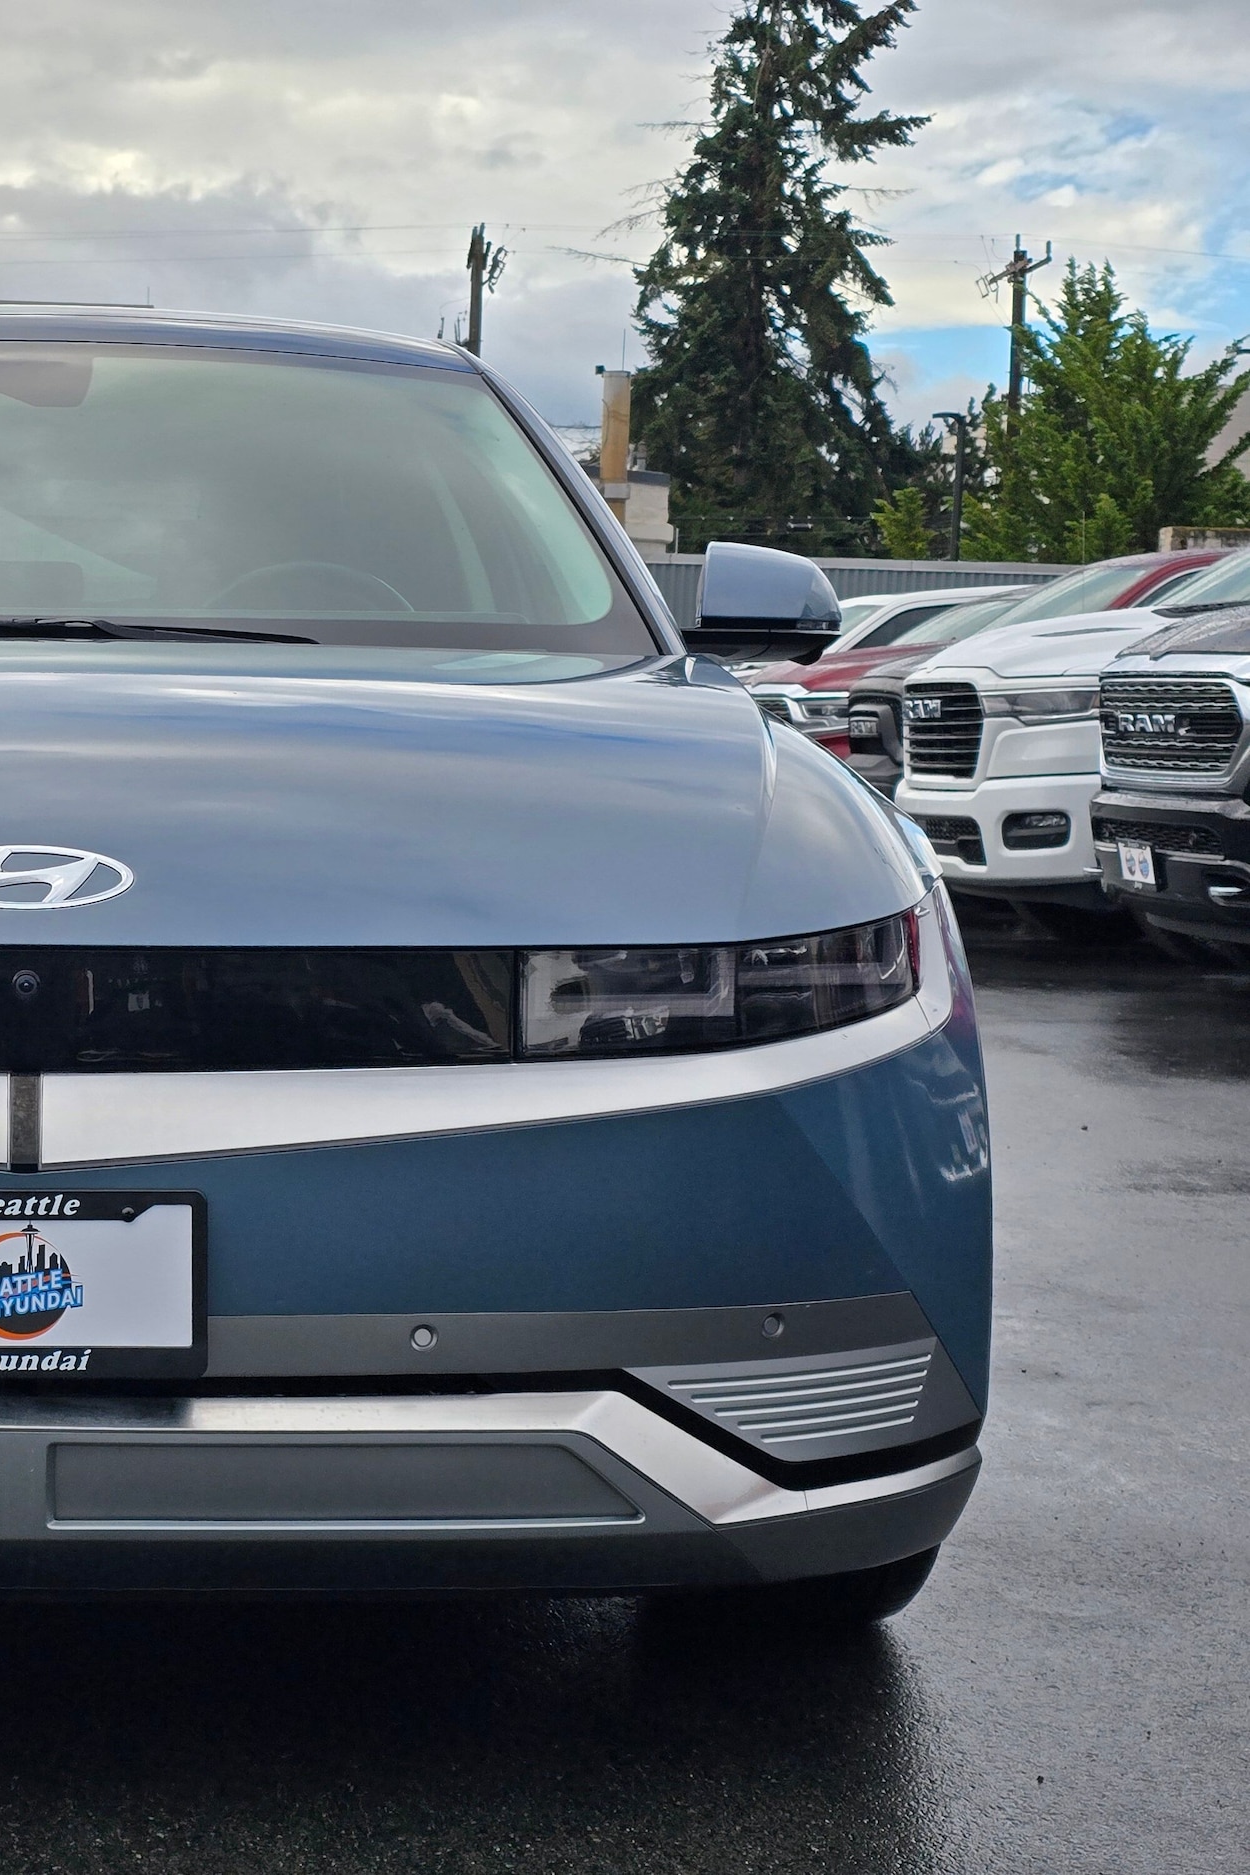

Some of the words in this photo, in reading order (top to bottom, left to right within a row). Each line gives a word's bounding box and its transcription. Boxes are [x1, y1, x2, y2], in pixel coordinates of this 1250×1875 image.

[903, 699, 942, 718] RAM
[851, 721, 877, 734] RAM
[1118, 714, 1176, 732] RAM
